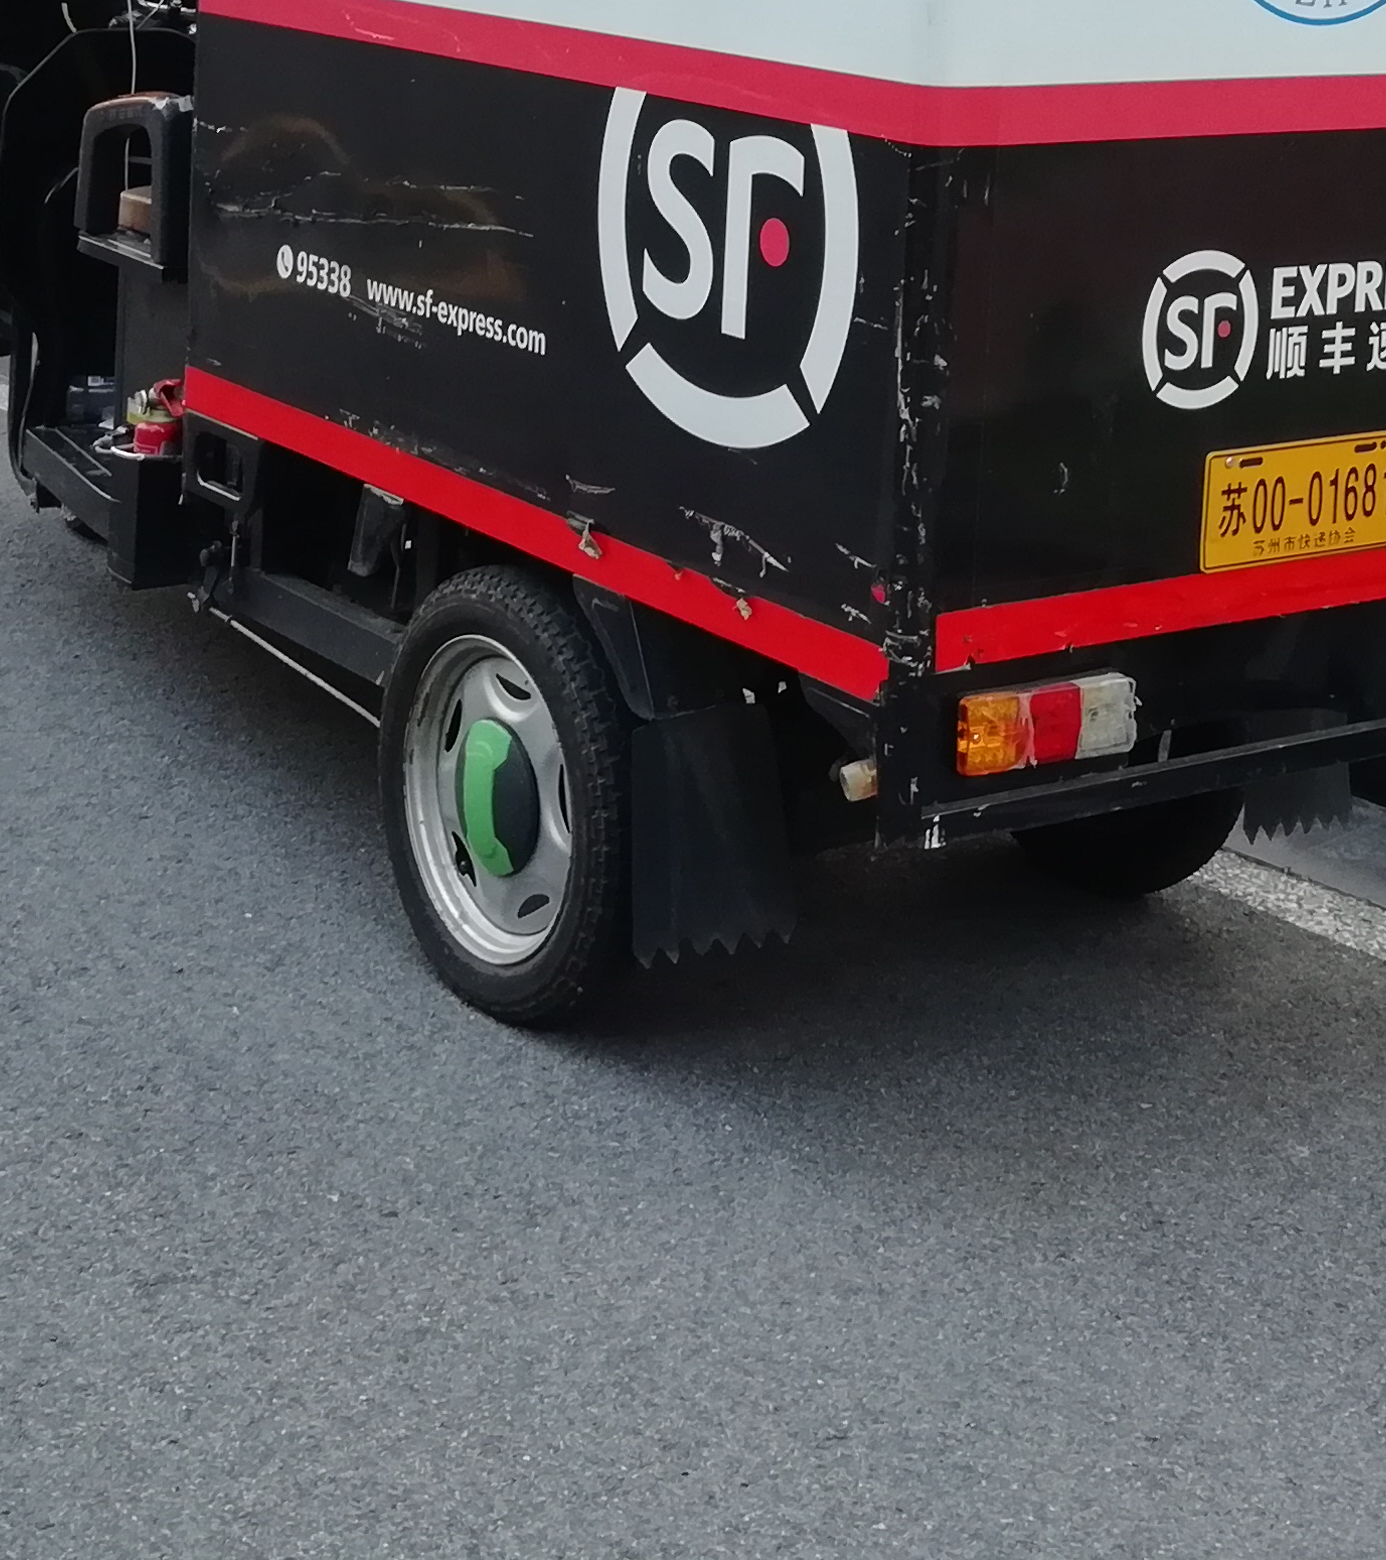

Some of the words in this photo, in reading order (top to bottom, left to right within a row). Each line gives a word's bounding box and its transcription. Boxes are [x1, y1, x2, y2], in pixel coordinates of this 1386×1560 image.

[643, 119, 805, 339] SF
[296, 251, 351, 297] 95338
[366, 278, 546, 355] www.sf-express.com
[1164, 292, 1238, 370] SF
